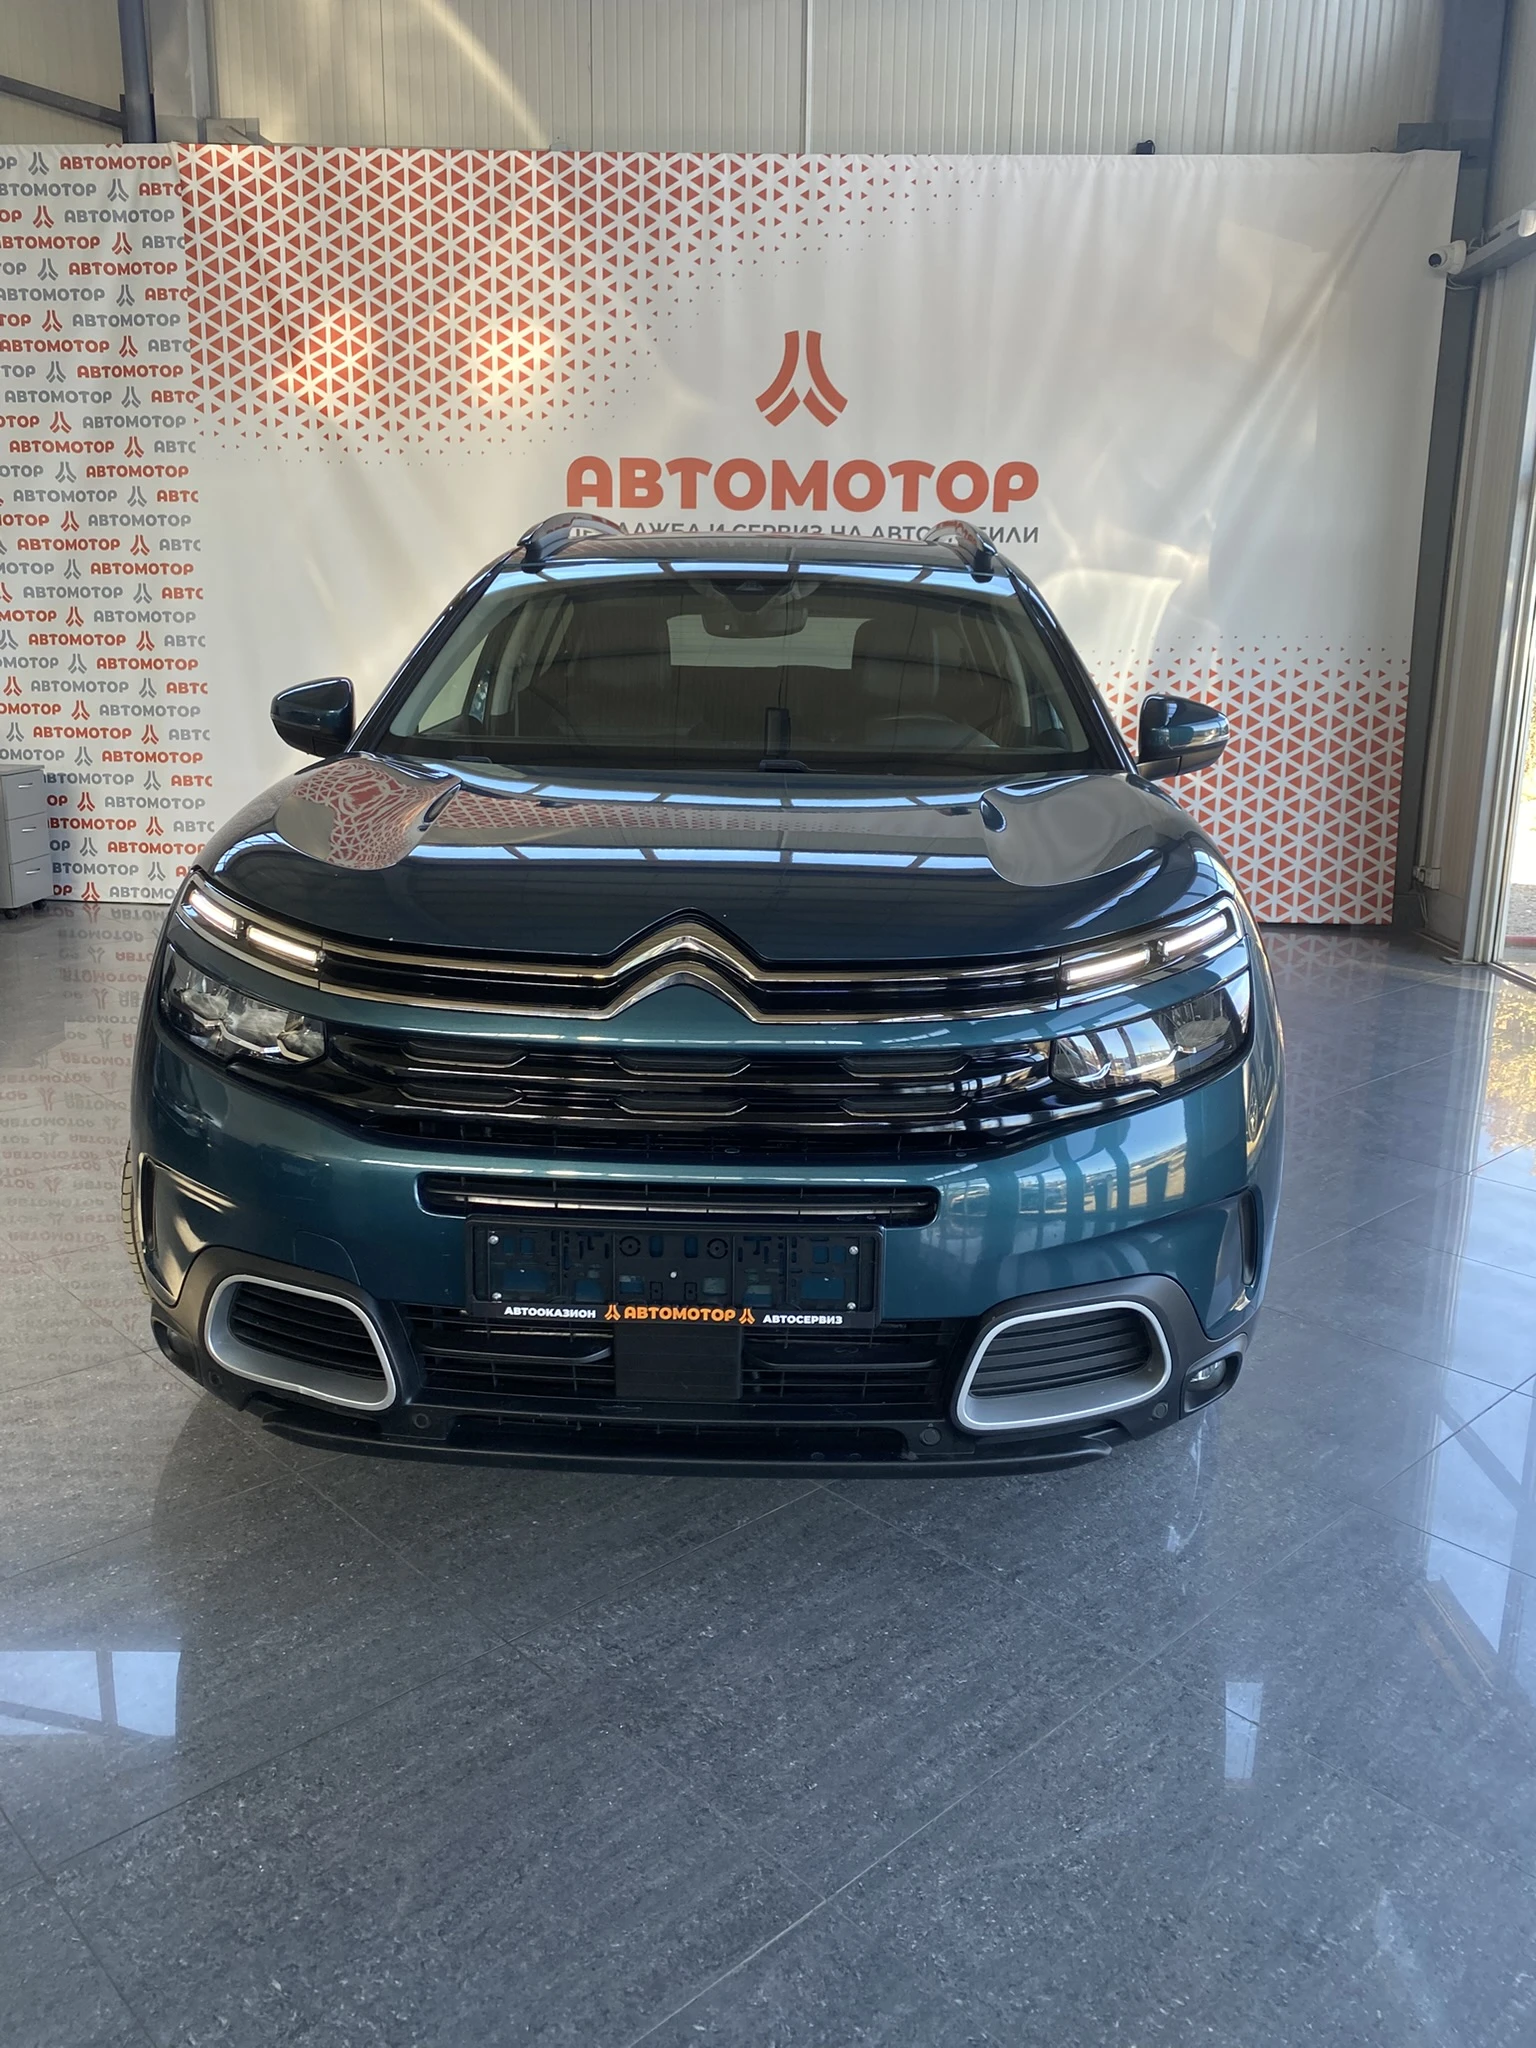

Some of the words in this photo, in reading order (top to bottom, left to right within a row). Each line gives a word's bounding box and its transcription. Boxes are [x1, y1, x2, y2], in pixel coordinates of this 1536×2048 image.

[60, 156, 172, 170] АВТОМОТОР
[64, 209, 175, 223] АВТОМОТОР
[0, 235, 100, 249] ВТОМОТОР
[69, 261, 177, 276] АВТОМОТОР
[73, 313, 180, 328] АВТОМОТОР
[0, 339, 110, 353] АВТОМОТОР
[77, 365, 183, 379] АВТОМОТОР
[5, 390, 112, 404] АВТОМОТОР
[83, 415, 186, 429] АВТОМОТОР
[10, 440, 114, 453] АВТОМОТОР
[86, 465, 189, 478] АВТОМОТОР
[566, 455, 1039, 513] АВТОМОТОР
[13, 489, 117, 502] АВТОМОТОР
[88, 514, 191, 527] АВТОМОТОР
[17, 538, 120, 551] АВТОМОТОР
[91, 562, 194, 575] АВТОМОТОР
[23, 586, 123, 599] АВТОМОТОР
[94, 610, 196, 623] АВТОМОТОР
[29, 633, 126, 646] АВТОМОТОР
[97, 657, 198, 670] АВТОМОТОР
[31, 680, 129, 693] АВТОМОТОР
[99, 704, 200, 717] АВТОМОТОР
[33, 726, 132, 739] АВТОМОТОР
[102, 750, 203, 764] АВТОМОТОР
[44, 772, 134, 785] ВТОМОТОР
[105, 796, 205, 809] АВТОМОТОР
[48, 818, 137, 831] ВТОМОТОР
[503, 1306, 597, 1319] АВТООКАЗИОН
[624, 1306, 736, 1322] АВТОМОТОР
[762, 1313, 843, 1326] АВТОСЕРВИЗ
